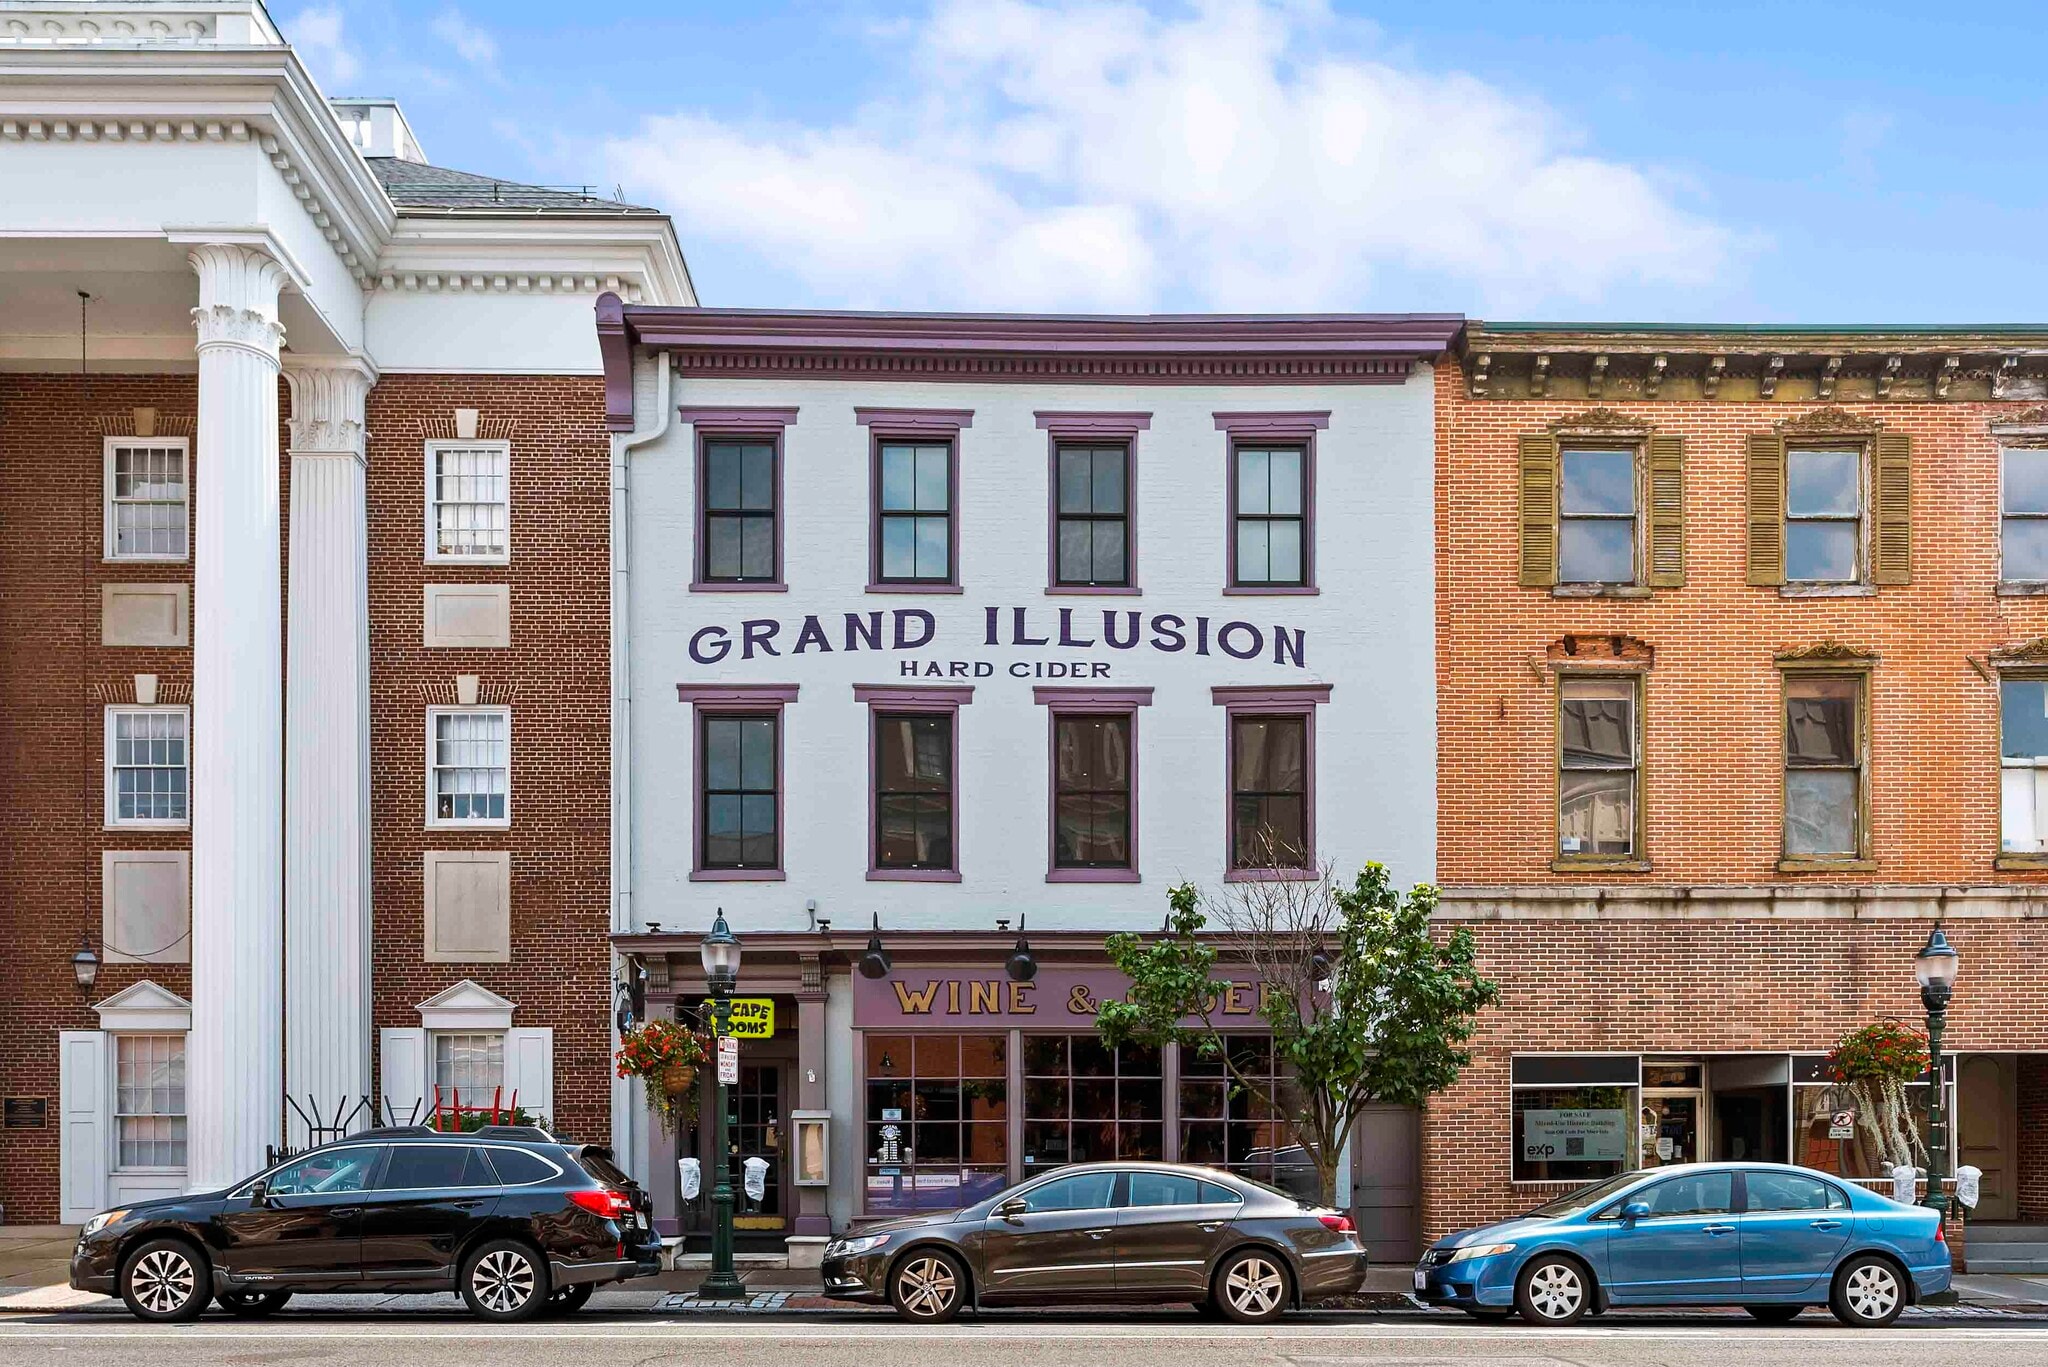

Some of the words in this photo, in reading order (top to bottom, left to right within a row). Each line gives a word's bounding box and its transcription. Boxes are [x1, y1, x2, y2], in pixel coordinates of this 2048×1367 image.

[689, 609, 936, 664] GRAND
[984, 607, 1307, 668] ILLUSION
[900, 660, 994, 678] HARD
[1009, 661, 1112, 679] CIDER
[891, 980, 1037, 1014] WINE
[1067, 984, 1097, 1014] &
[729, 1003, 770, 1019] CAPE
[725, 1021, 768, 1034] OOMS
